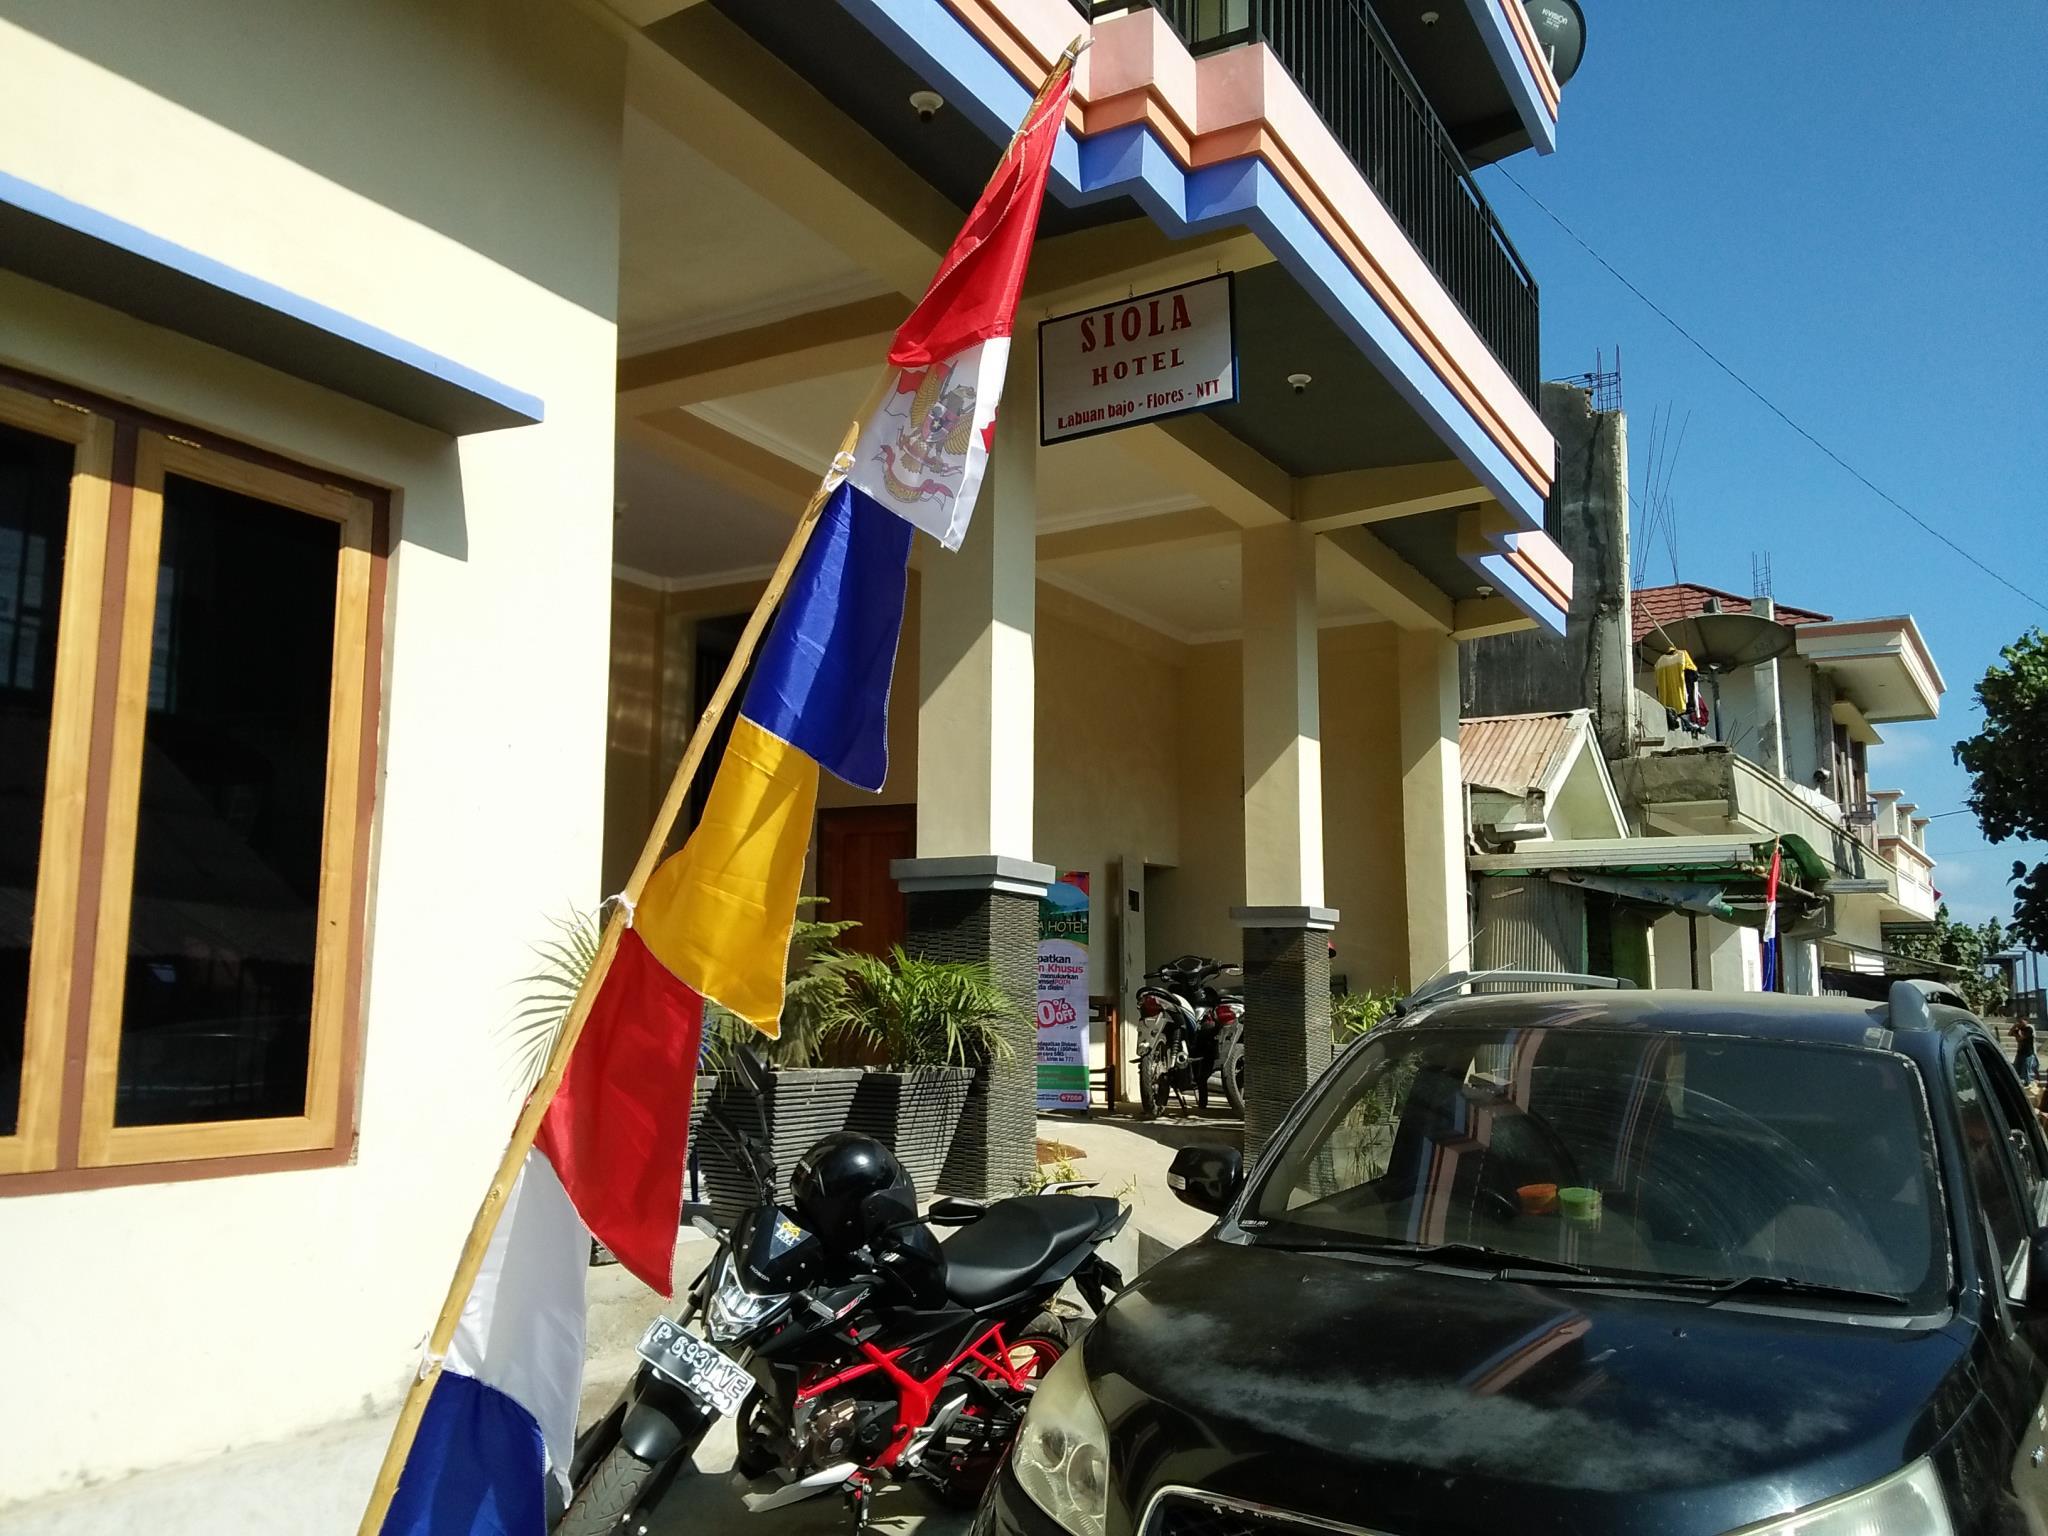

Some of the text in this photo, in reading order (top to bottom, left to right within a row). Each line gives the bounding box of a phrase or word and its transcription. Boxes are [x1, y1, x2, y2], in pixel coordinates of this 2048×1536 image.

[1080, 295, 1191, 352] SIOLA
[1092, 348, 1184, 386] HOTEL
[1058, 406, 1105, 430] Labuan
[1108, 400, 1135, 418] bajo
[1147, 388, 1184, 409] Flores
[1196, 379, 1220, 399] NTT
[1048, 921, 1087, 933] HOTEL
[1048, 964, 1084, 974] Khusus
[1056, 1009, 1074, 1023] OFF
[749, 1264, 770, 1281] HONDA
[651, 1322, 672, 1343] P
[671, 1335, 718, 1377] 6931
[719, 1365, 748, 1399] VE
